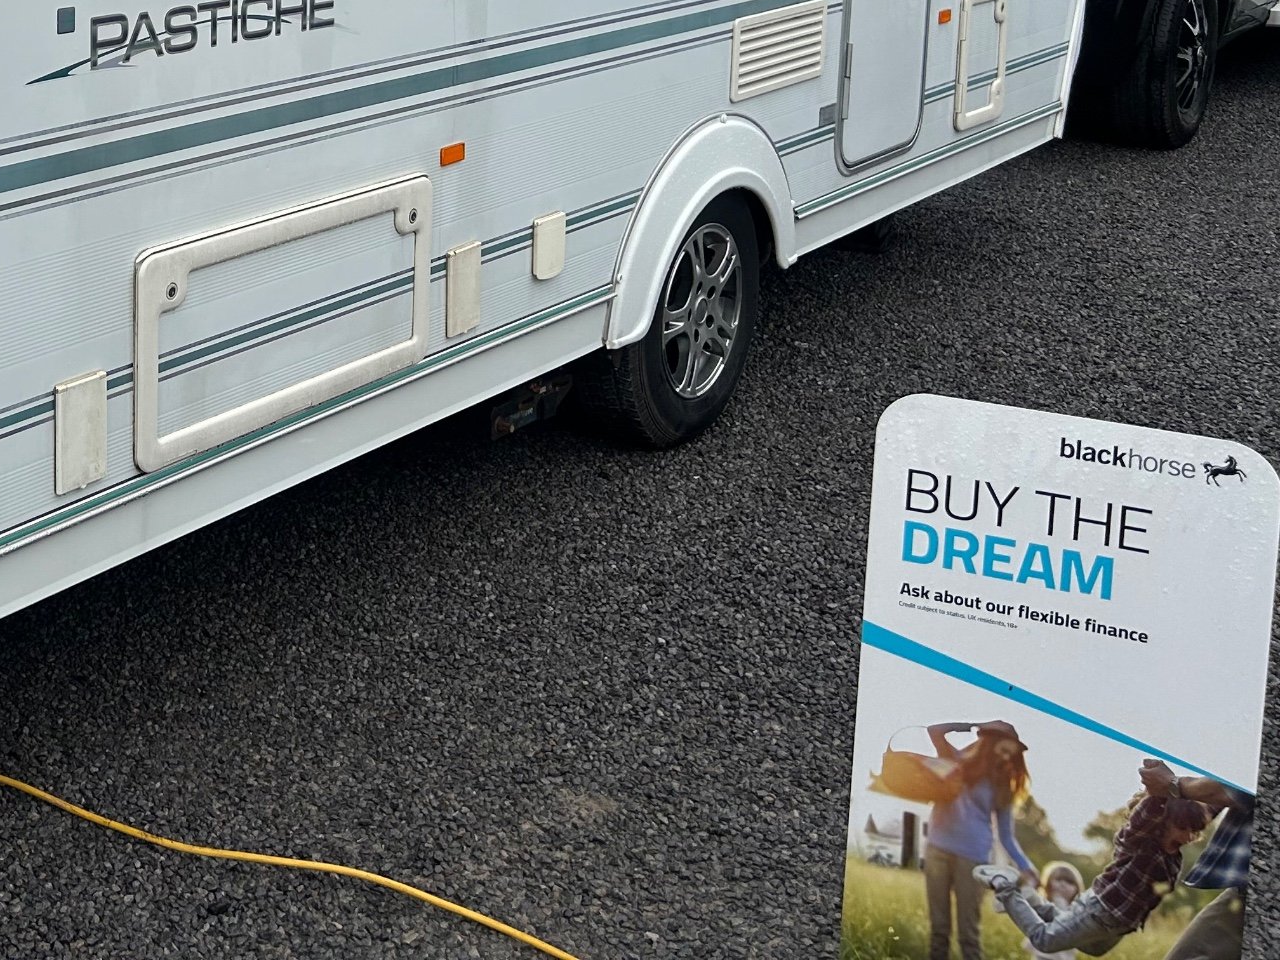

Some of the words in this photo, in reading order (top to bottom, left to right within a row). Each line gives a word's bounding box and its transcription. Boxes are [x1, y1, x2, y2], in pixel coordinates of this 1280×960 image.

[904, 468, 1020, 527] BUY
[1035, 489, 1153, 555] THE
[901, 520, 1115, 601] DREAM
[900, 582, 930, 600] Ask
[934, 590, 982, 610] about
[985, 601, 1014, 616] our
[1018, 605, 1080, 629] flexible
[1084, 618, 1149, 643] finance
